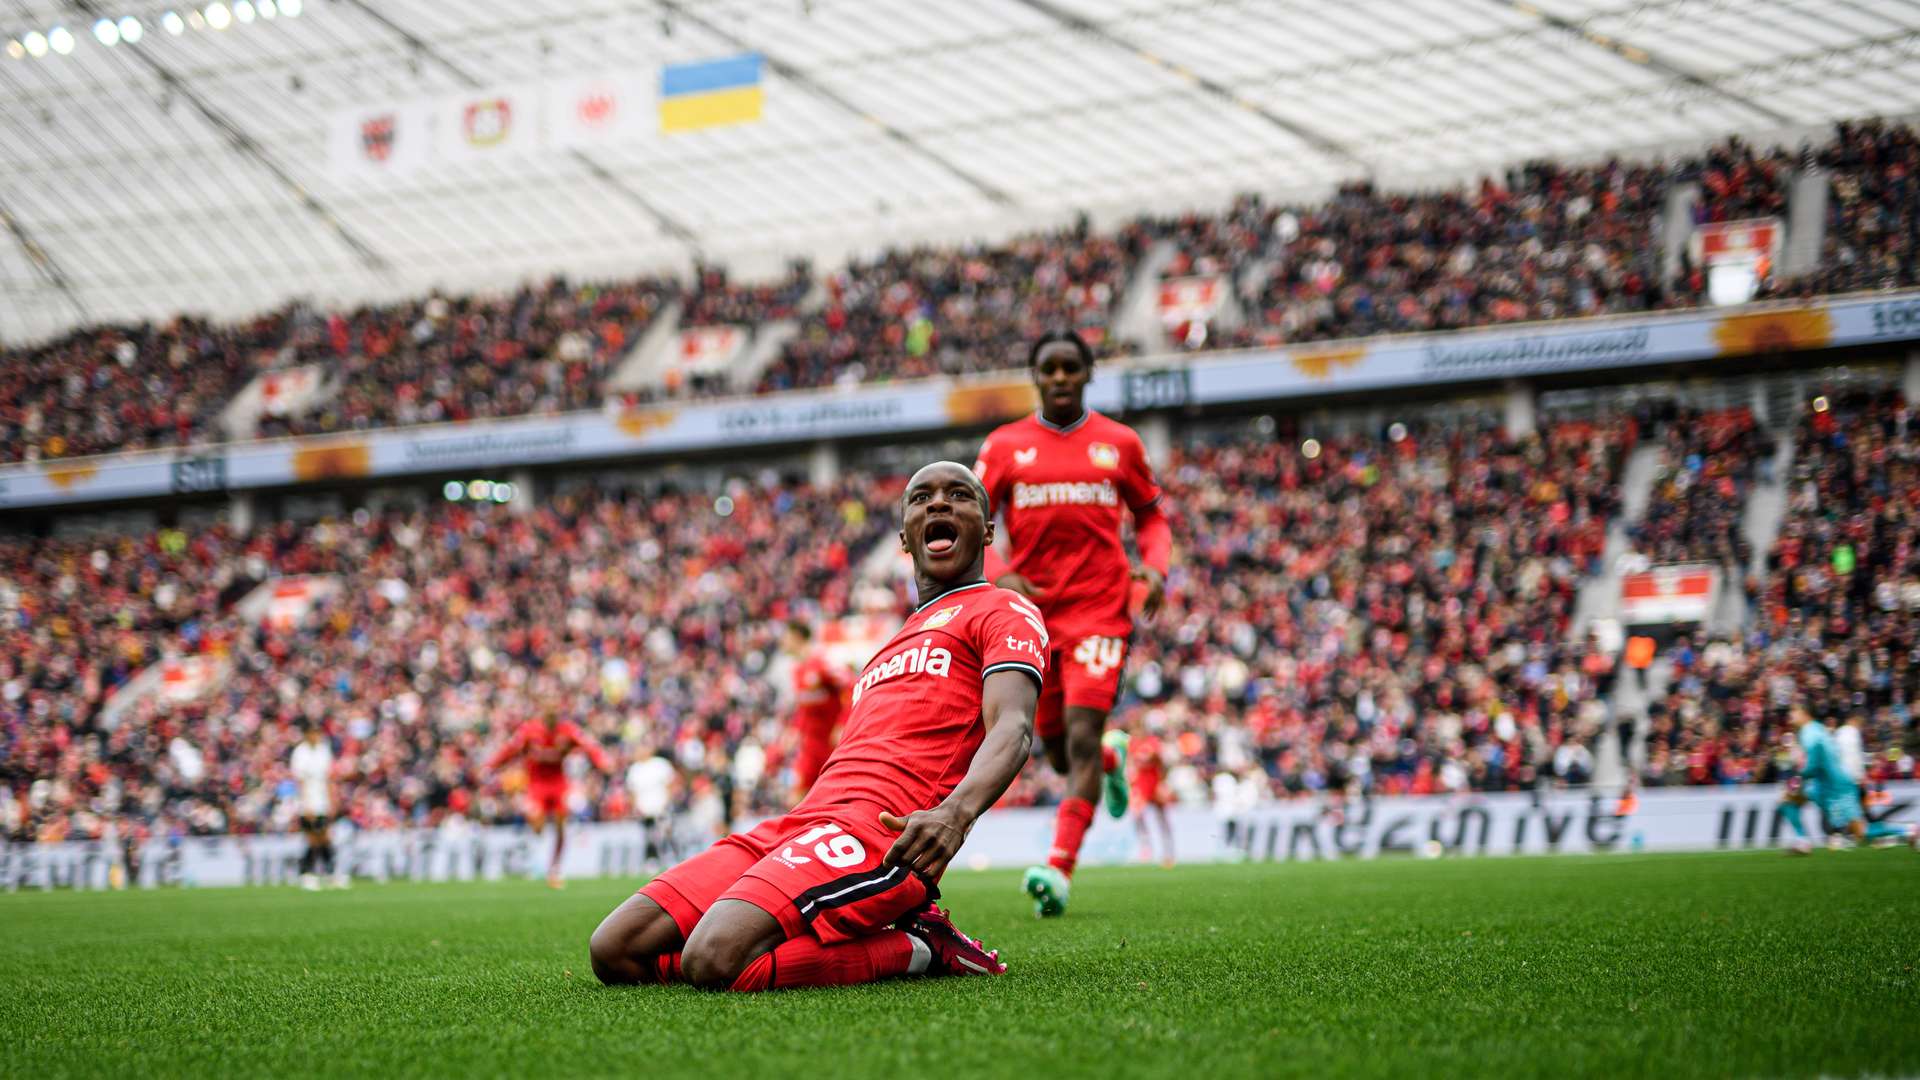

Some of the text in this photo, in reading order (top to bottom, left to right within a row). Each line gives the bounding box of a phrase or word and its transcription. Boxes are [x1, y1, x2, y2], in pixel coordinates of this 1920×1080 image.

[1013, 479, 1118, 509] Barmenia
[852, 638, 952, 706] armenia
[795, 823, 866, 868] 19
